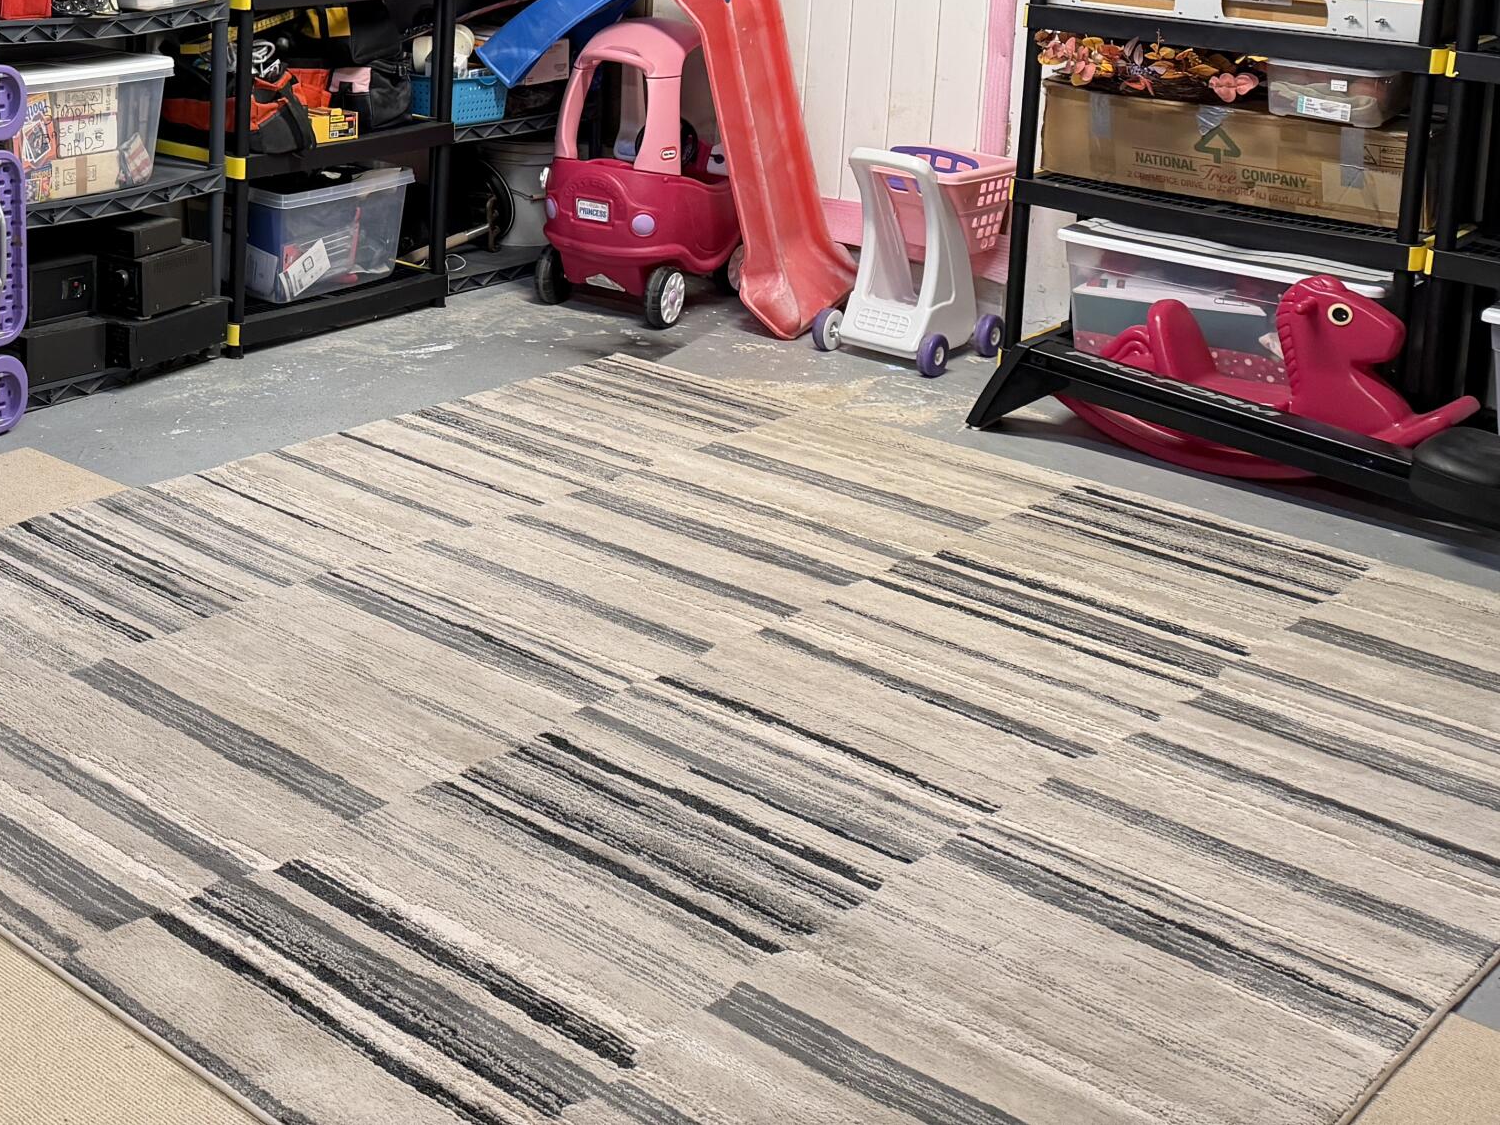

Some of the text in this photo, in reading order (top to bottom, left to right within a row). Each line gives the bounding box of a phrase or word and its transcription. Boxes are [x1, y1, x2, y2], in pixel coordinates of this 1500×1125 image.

[1134, 150, 1308, 189] NATIONAL Tree COMPANY
[579, 206, 607, 219] PRINCESS
